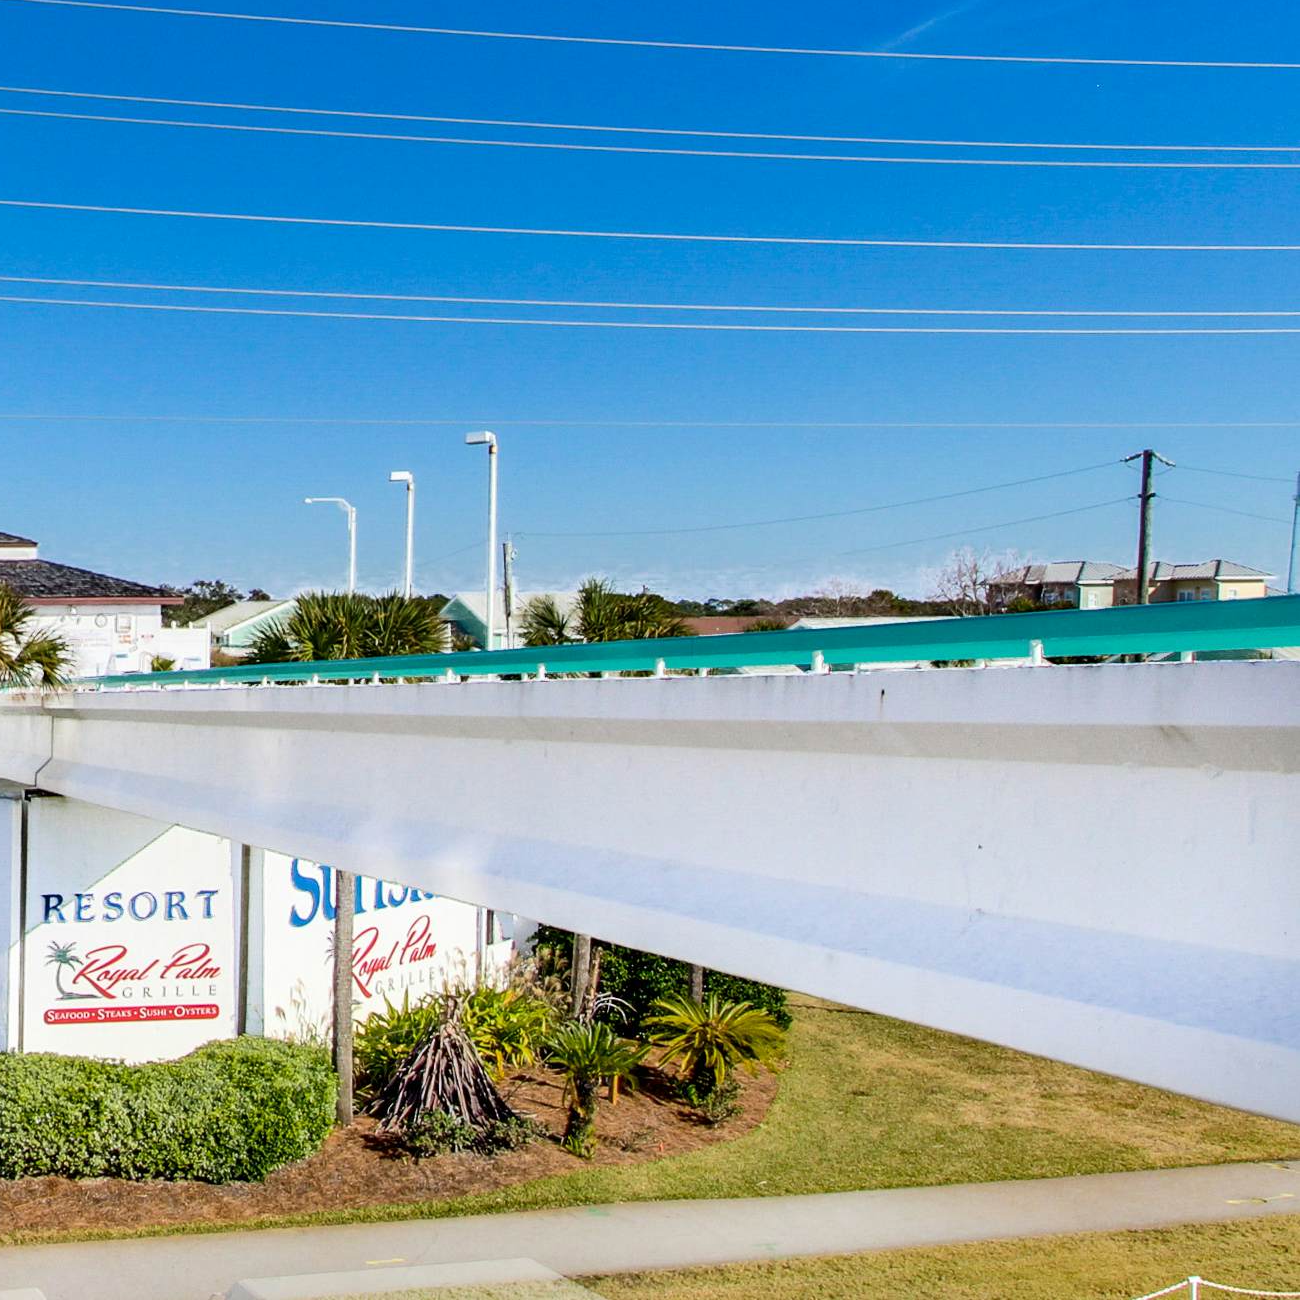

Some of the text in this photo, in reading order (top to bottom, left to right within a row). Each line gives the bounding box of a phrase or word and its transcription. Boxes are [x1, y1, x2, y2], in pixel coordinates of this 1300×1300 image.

[40, 889, 219, 924] RESORT
[71, 943, 221, 999] Royal Palm
[351, 915, 437, 998] Royal Palm
[122, 984, 217, 999] GRILLE
[46, 1005, 218, 1022] SEAFOOD STEAKS SUSHI OYSTERS
